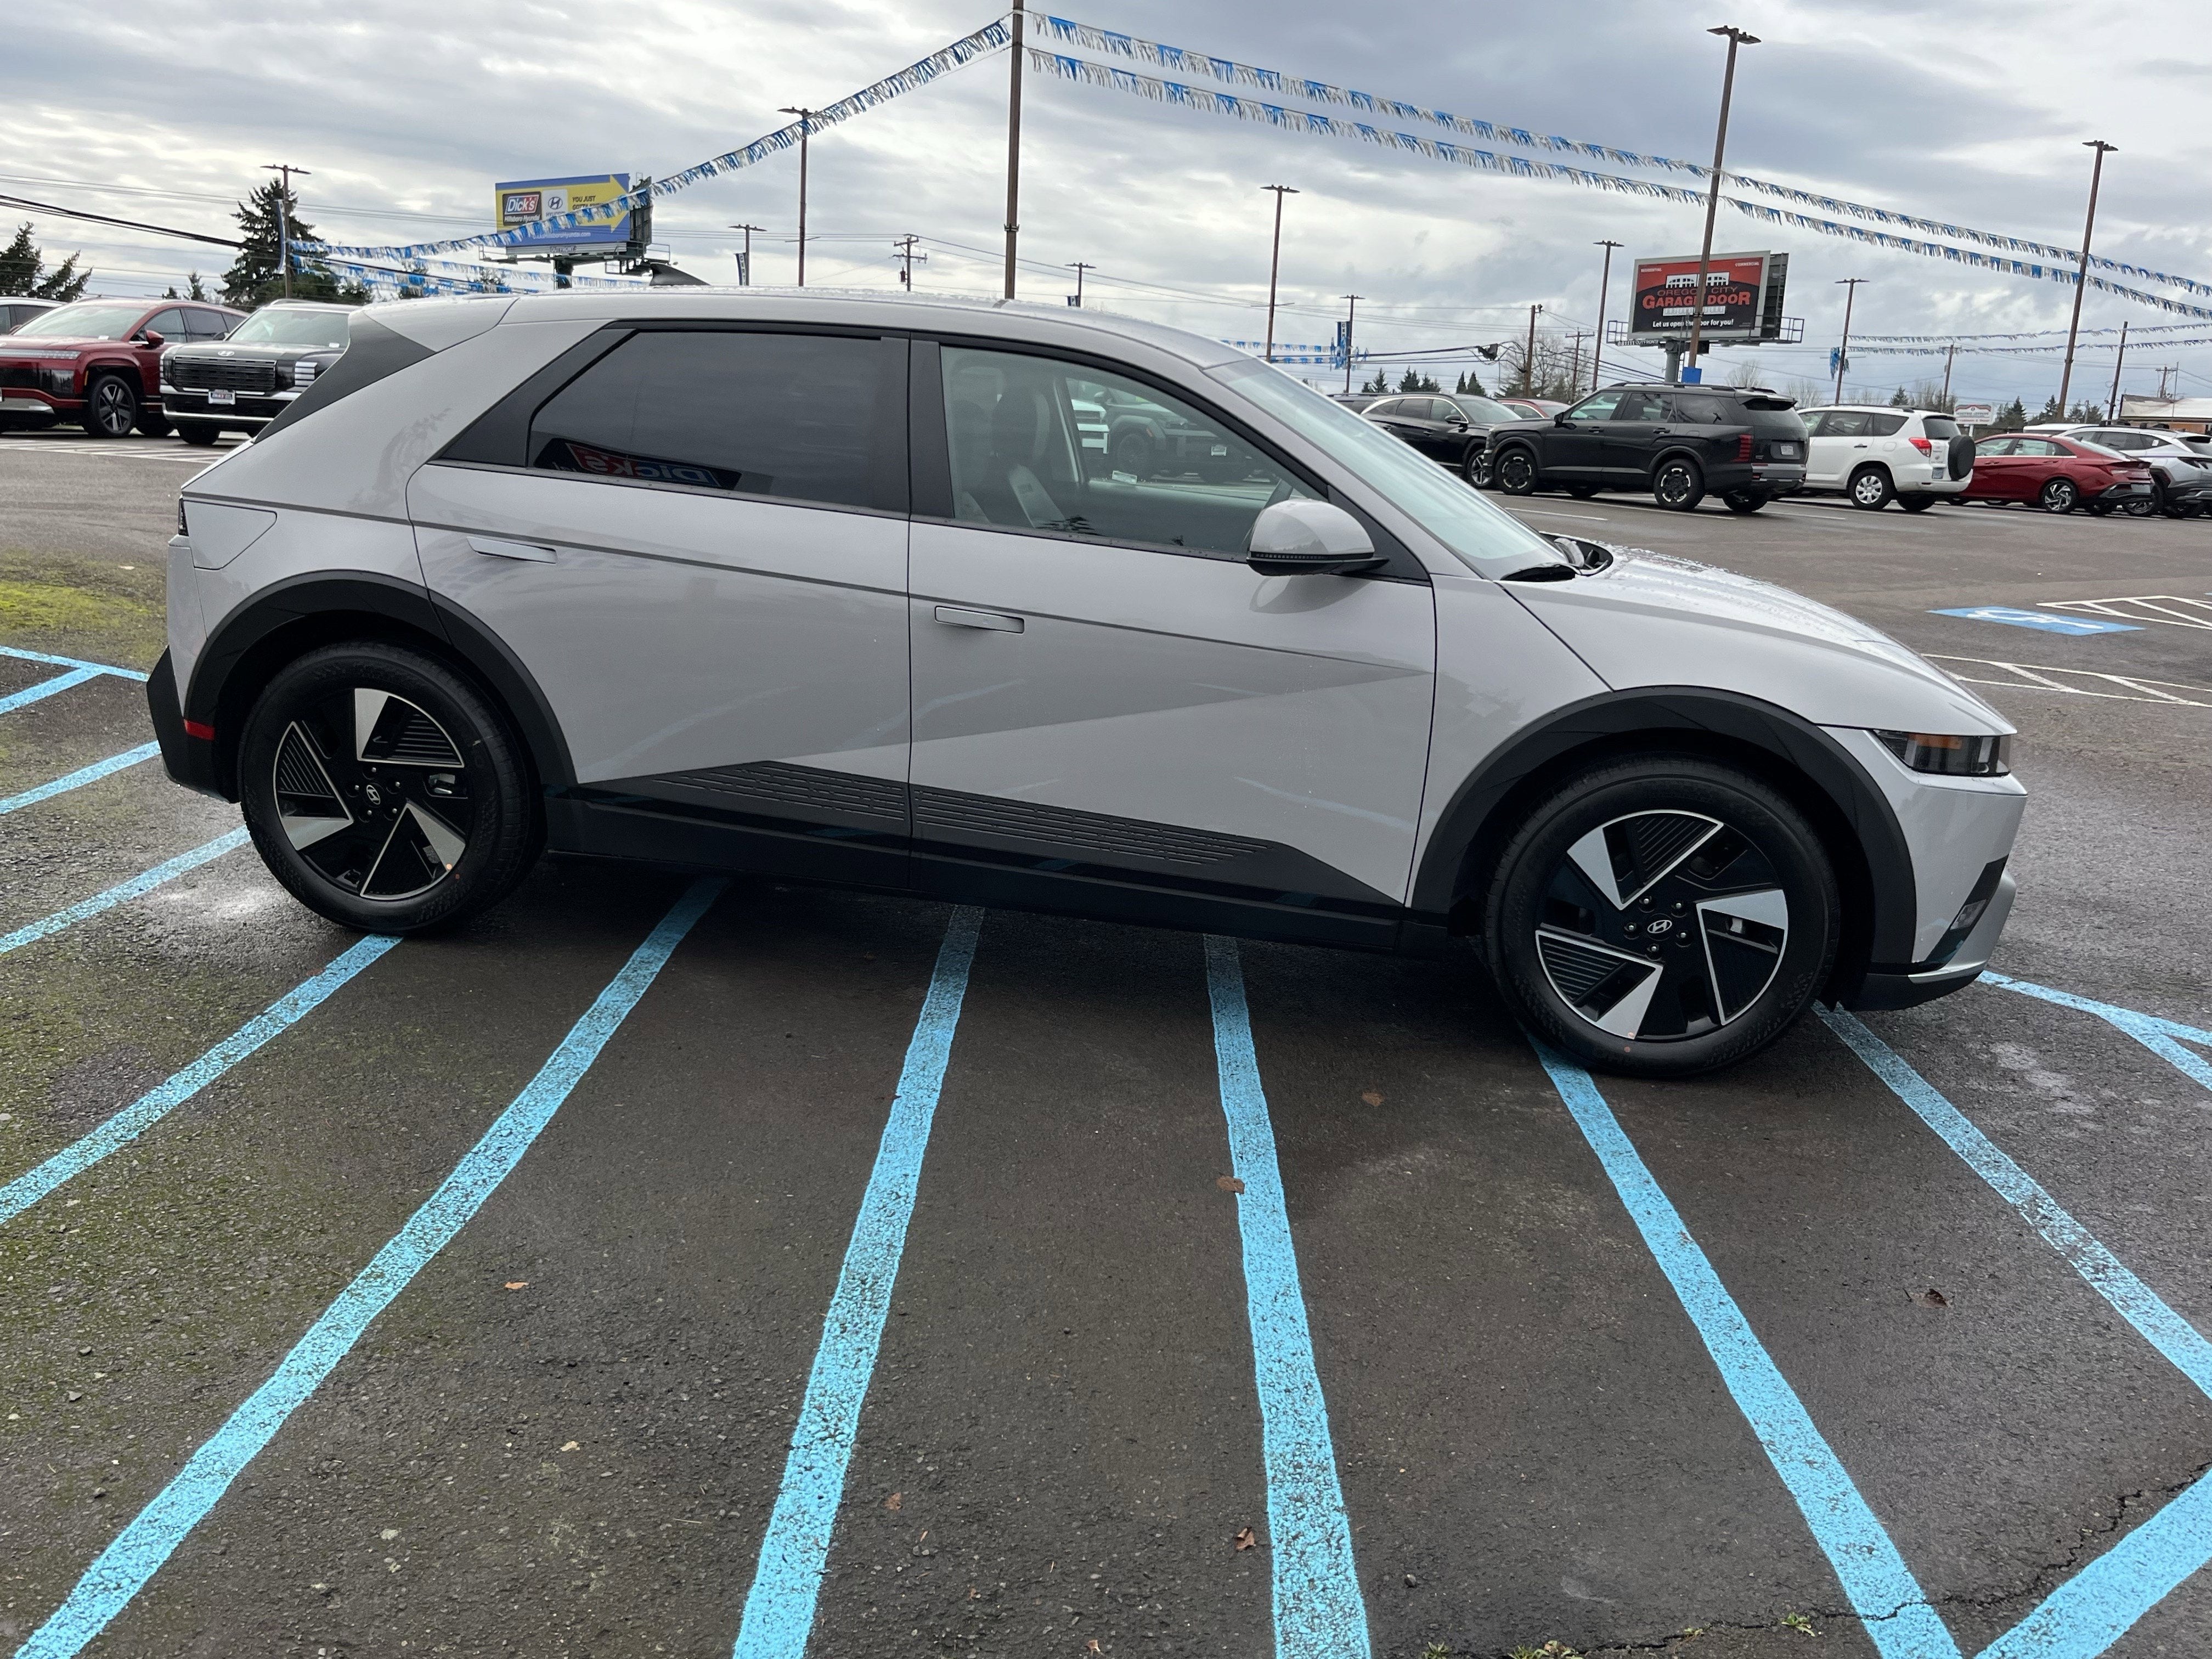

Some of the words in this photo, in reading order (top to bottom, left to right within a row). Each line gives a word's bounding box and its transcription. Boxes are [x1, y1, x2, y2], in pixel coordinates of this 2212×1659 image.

[506, 197, 535, 212] Dick's
[1657, 287, 1706, 296] OREGO
[1642, 295, 1696, 309] GARAG
[1707, 291, 1751, 306] DOOR
[1719, 318, 1734, 327] you!
